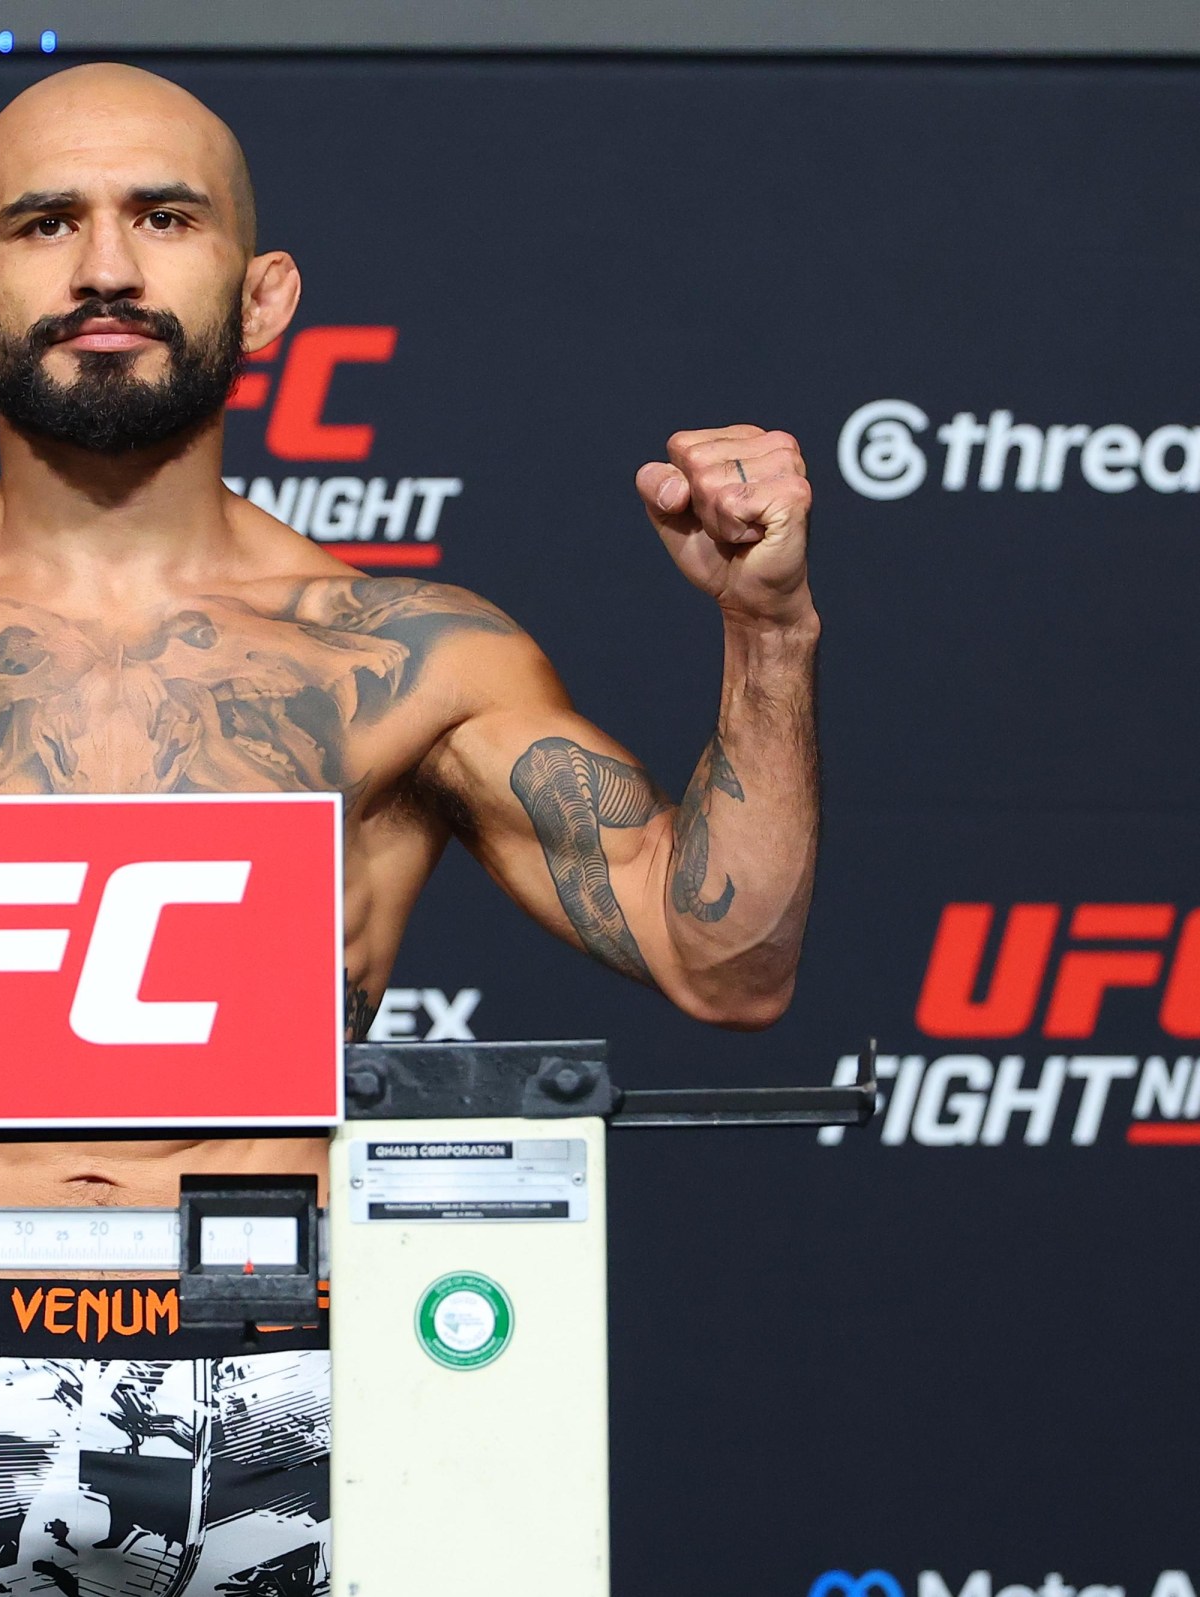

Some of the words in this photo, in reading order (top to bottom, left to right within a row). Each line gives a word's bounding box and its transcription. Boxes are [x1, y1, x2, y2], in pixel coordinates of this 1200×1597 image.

[367, 987, 482, 1041] EX
[13, 1220, 35, 1235] 30
[55, 1230, 70, 1240] 25
[88, 1220, 110, 1235] 20
[132, 1230, 145, 1240] 15
[208, 1231, 216, 1241] 5
[242, 1221, 254, 1236] 0
[11, 1286, 179, 1343] VENUM
